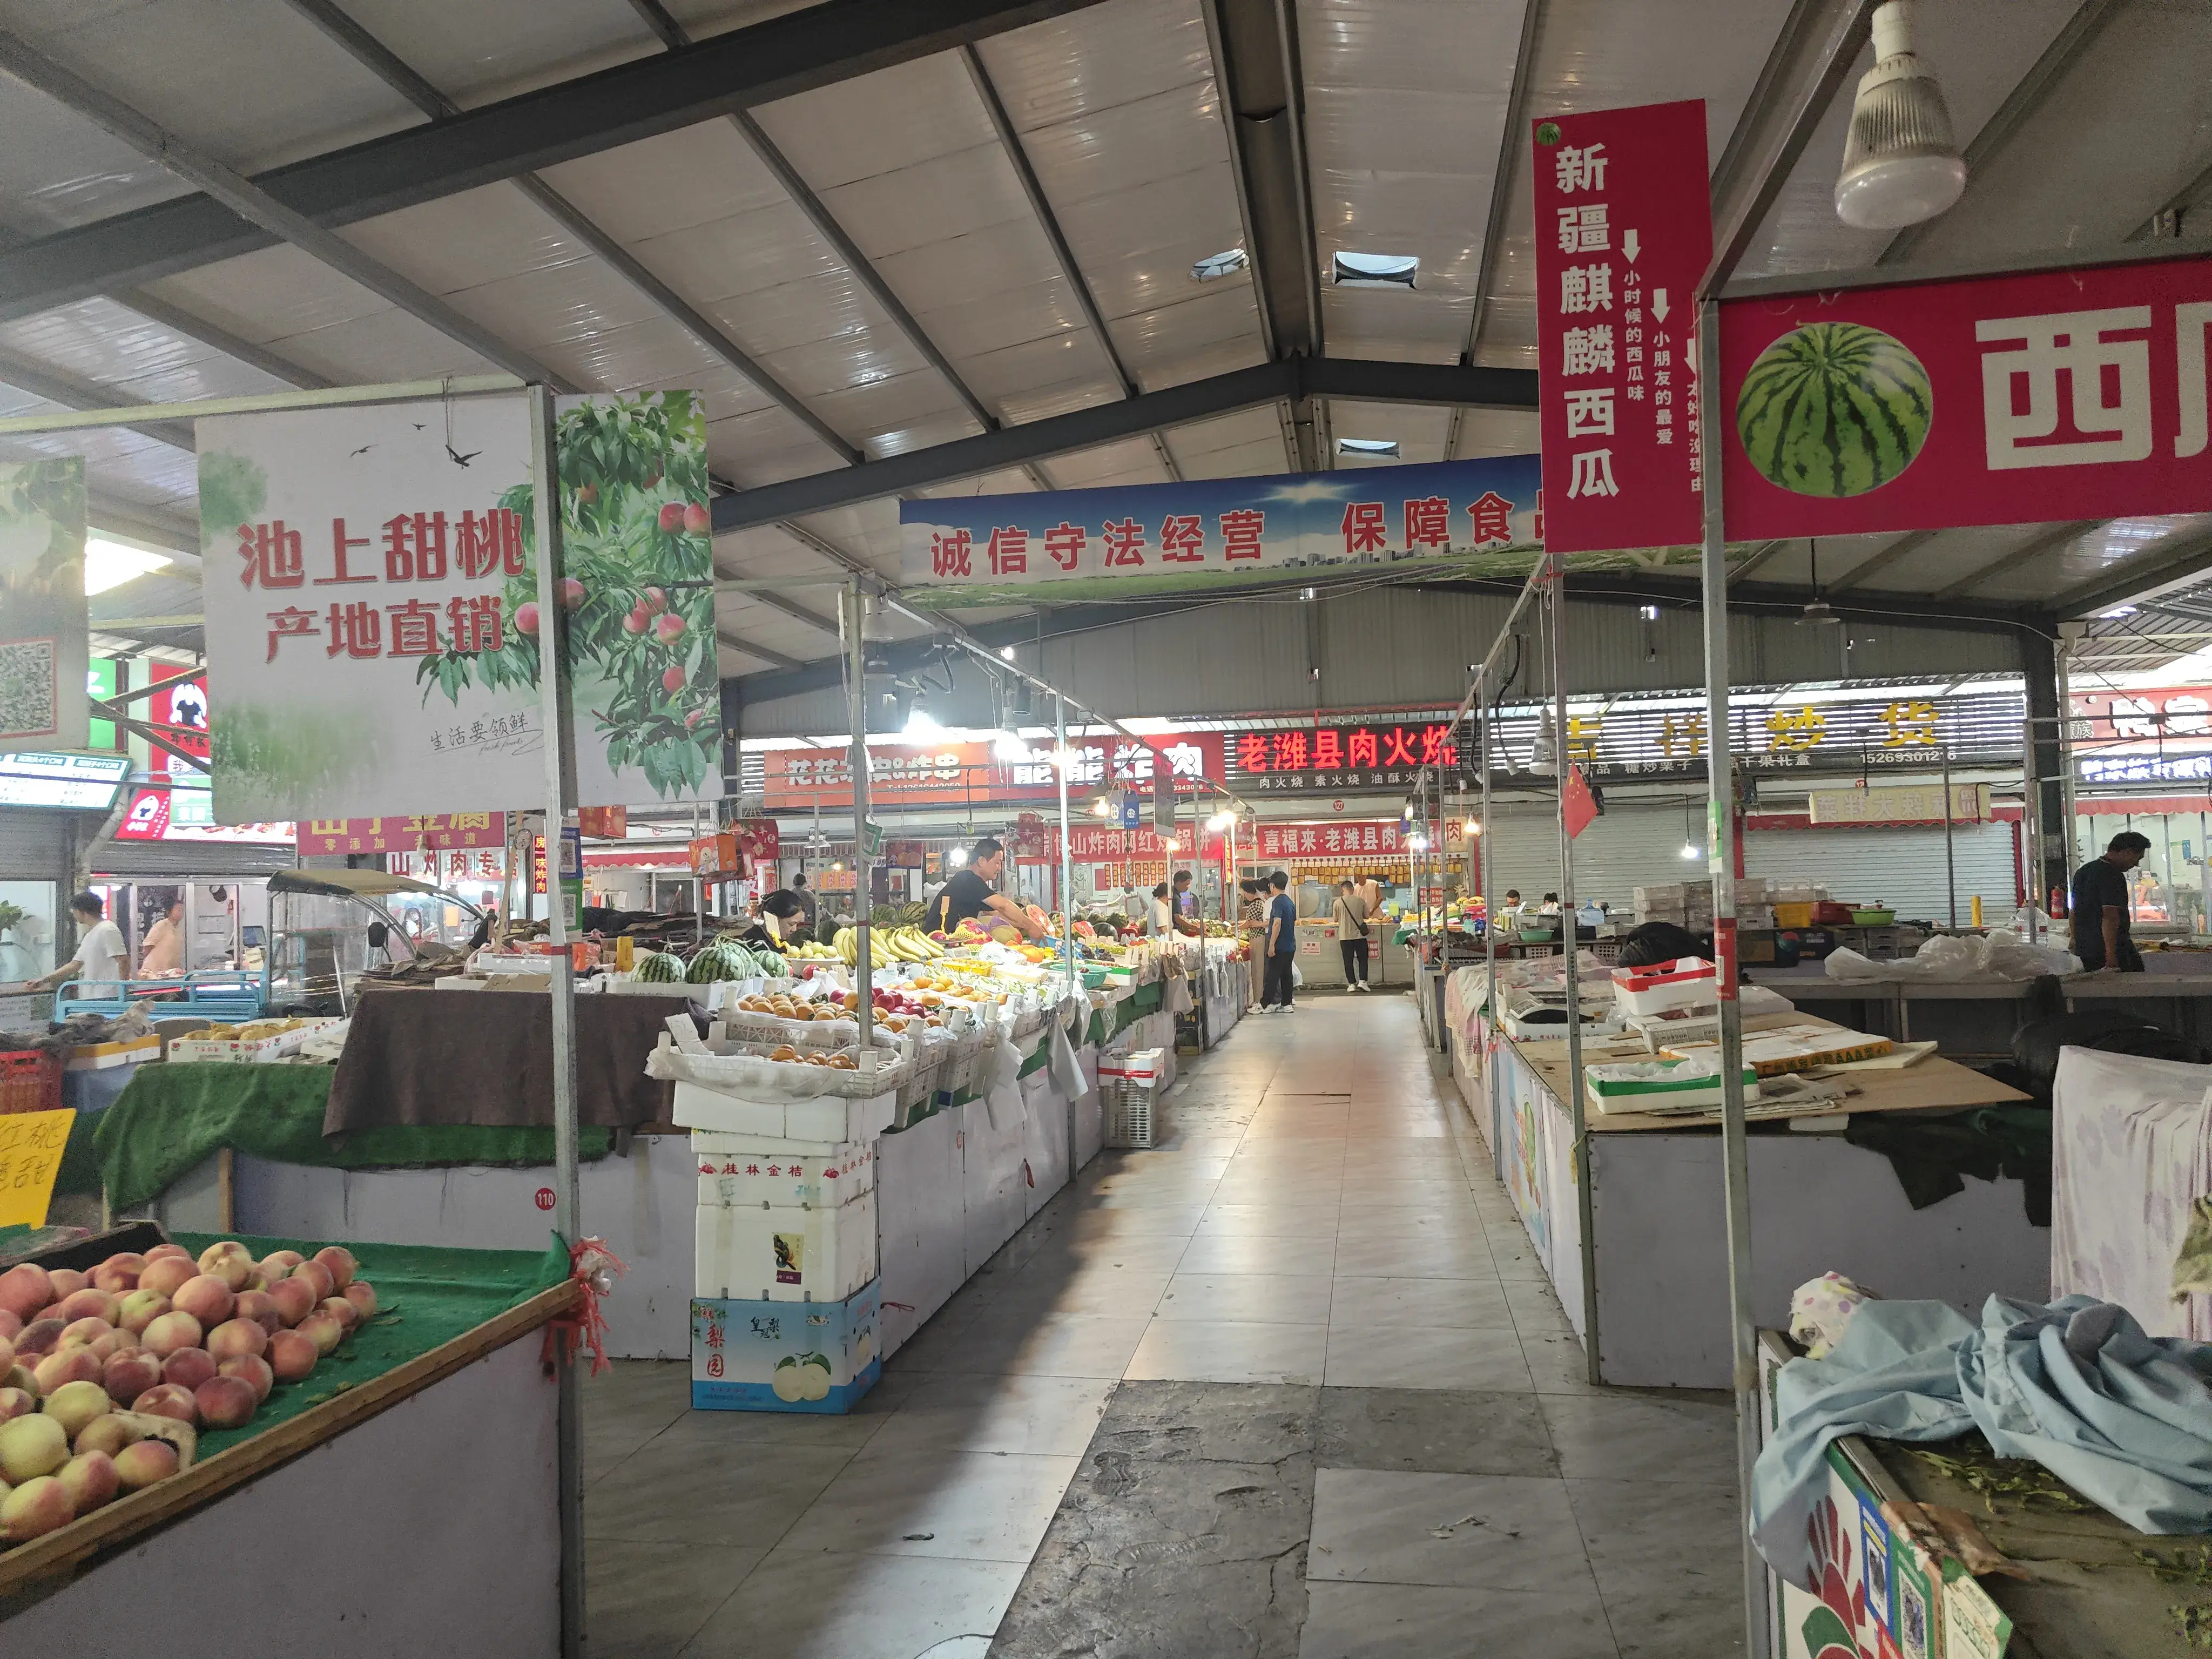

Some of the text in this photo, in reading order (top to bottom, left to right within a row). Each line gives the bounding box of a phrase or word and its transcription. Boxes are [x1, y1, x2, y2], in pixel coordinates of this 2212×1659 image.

[1556, 143, 1619, 500] 新疆麒麟西瓜
[1623, 270, 1644, 402] 小时候的西瓜味
[1653, 331, 1673, 446] 小朋友的最爱
[238, 508, 525, 591] 池上甜桃
[930, 490, 1543, 579] 诚信守法经营 保障食
[266, 595, 504, 664] 产地直销
[1236, 726, 1459, 772] 老潍县肉火烧
[1860, 751, 1957, 764] 1526930126
[1259, 776, 1304, 789] 肉火烧
[1314, 774, 1360, 786] 素火烧
[1625, 760, 1693, 774] 糖炒栗子
[325, 836, 386, 851] 零添加
[1446, 819, 1461, 841] 肉
[725, 1162, 803, 1177] 桂林金桔
[537, 1192, 554, 1206] 110
